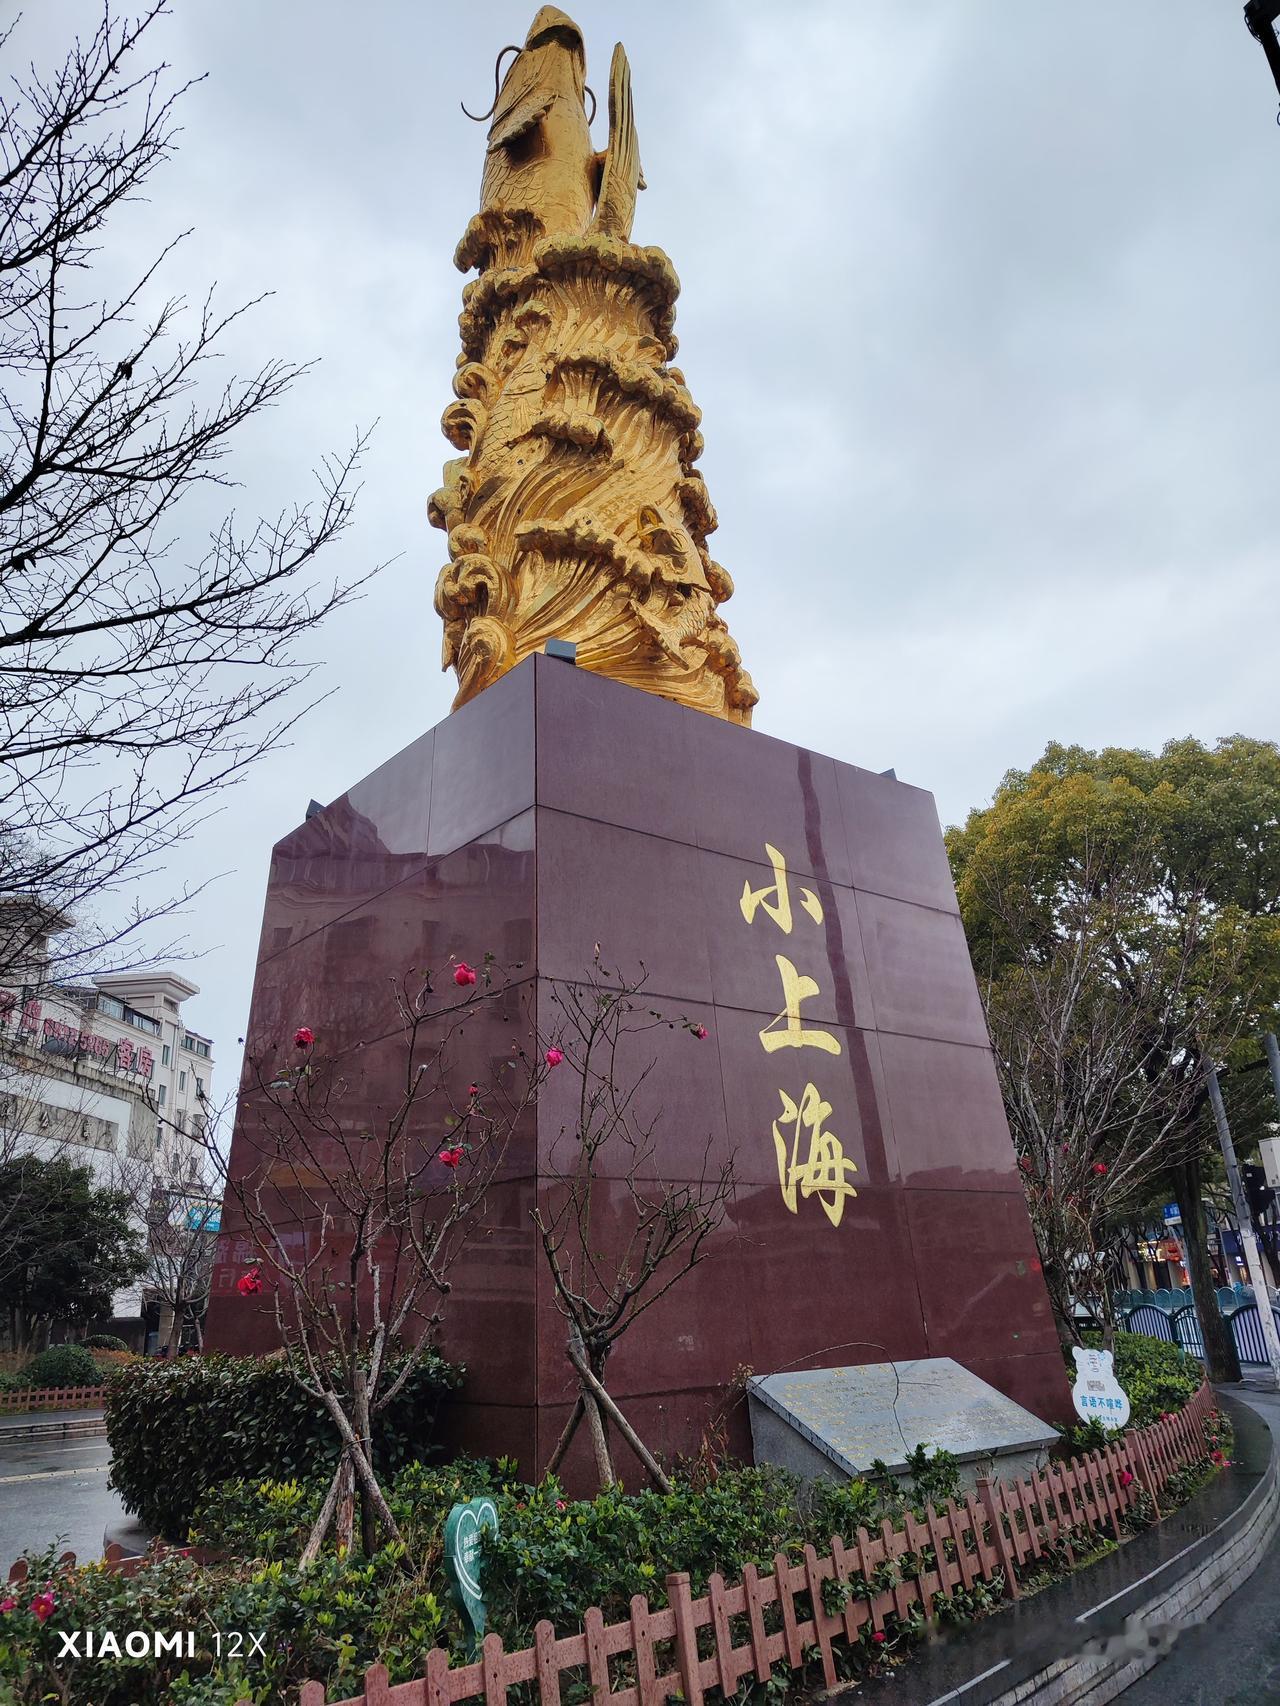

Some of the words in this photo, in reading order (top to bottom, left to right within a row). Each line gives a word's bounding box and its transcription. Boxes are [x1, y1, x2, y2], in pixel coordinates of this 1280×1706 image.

[739, 842, 858, 1228] 小上海
[117, 1037, 154, 1077] 客房
[1080, 1395, 1123, 1411] 言语不喧哗
